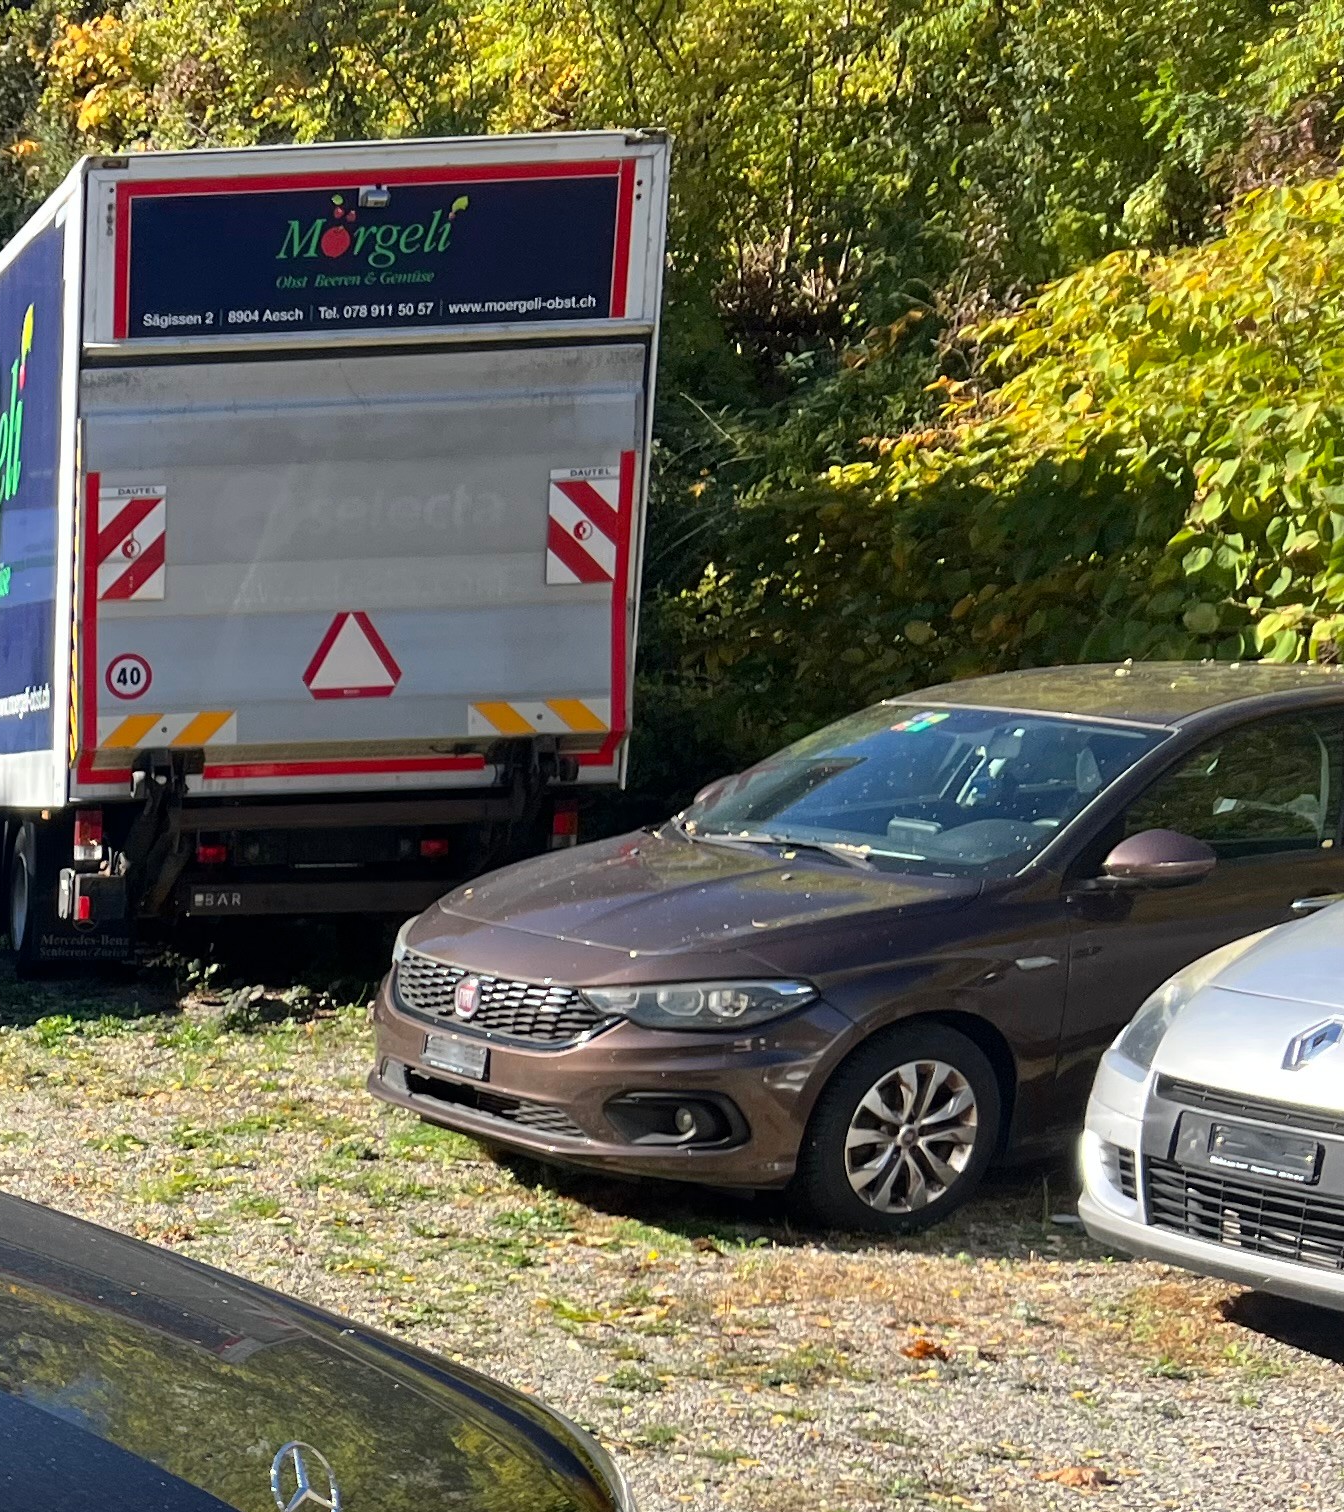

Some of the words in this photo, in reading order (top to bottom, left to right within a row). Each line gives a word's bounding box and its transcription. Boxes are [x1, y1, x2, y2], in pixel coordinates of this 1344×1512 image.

[276, 275, 308, 289] Obst
[315, 273, 361, 288] Beeren
[364, 272, 377, 286] &
[142, 311, 202, 329] Sägissen
[205, 311, 214, 325] 2
[227, 309, 260, 324] 8904
[262, 307, 304, 322] Aesch
[318, 305, 340, 320] Tel.
[343, 304, 368, 319] 078
[370, 303, 393, 317] 911
[398, 302, 414, 316] 50
[417, 302, 434, 316] 57
[448, 294, 596, 315] www.moergeli-obst.ch
[570, 469, 611, 478] DAUTEL
[117, 488, 158, 496] DAUTEL
[116, 667, 141, 686] 40
[40, 934, 129, 946] Mercedes-Benz
